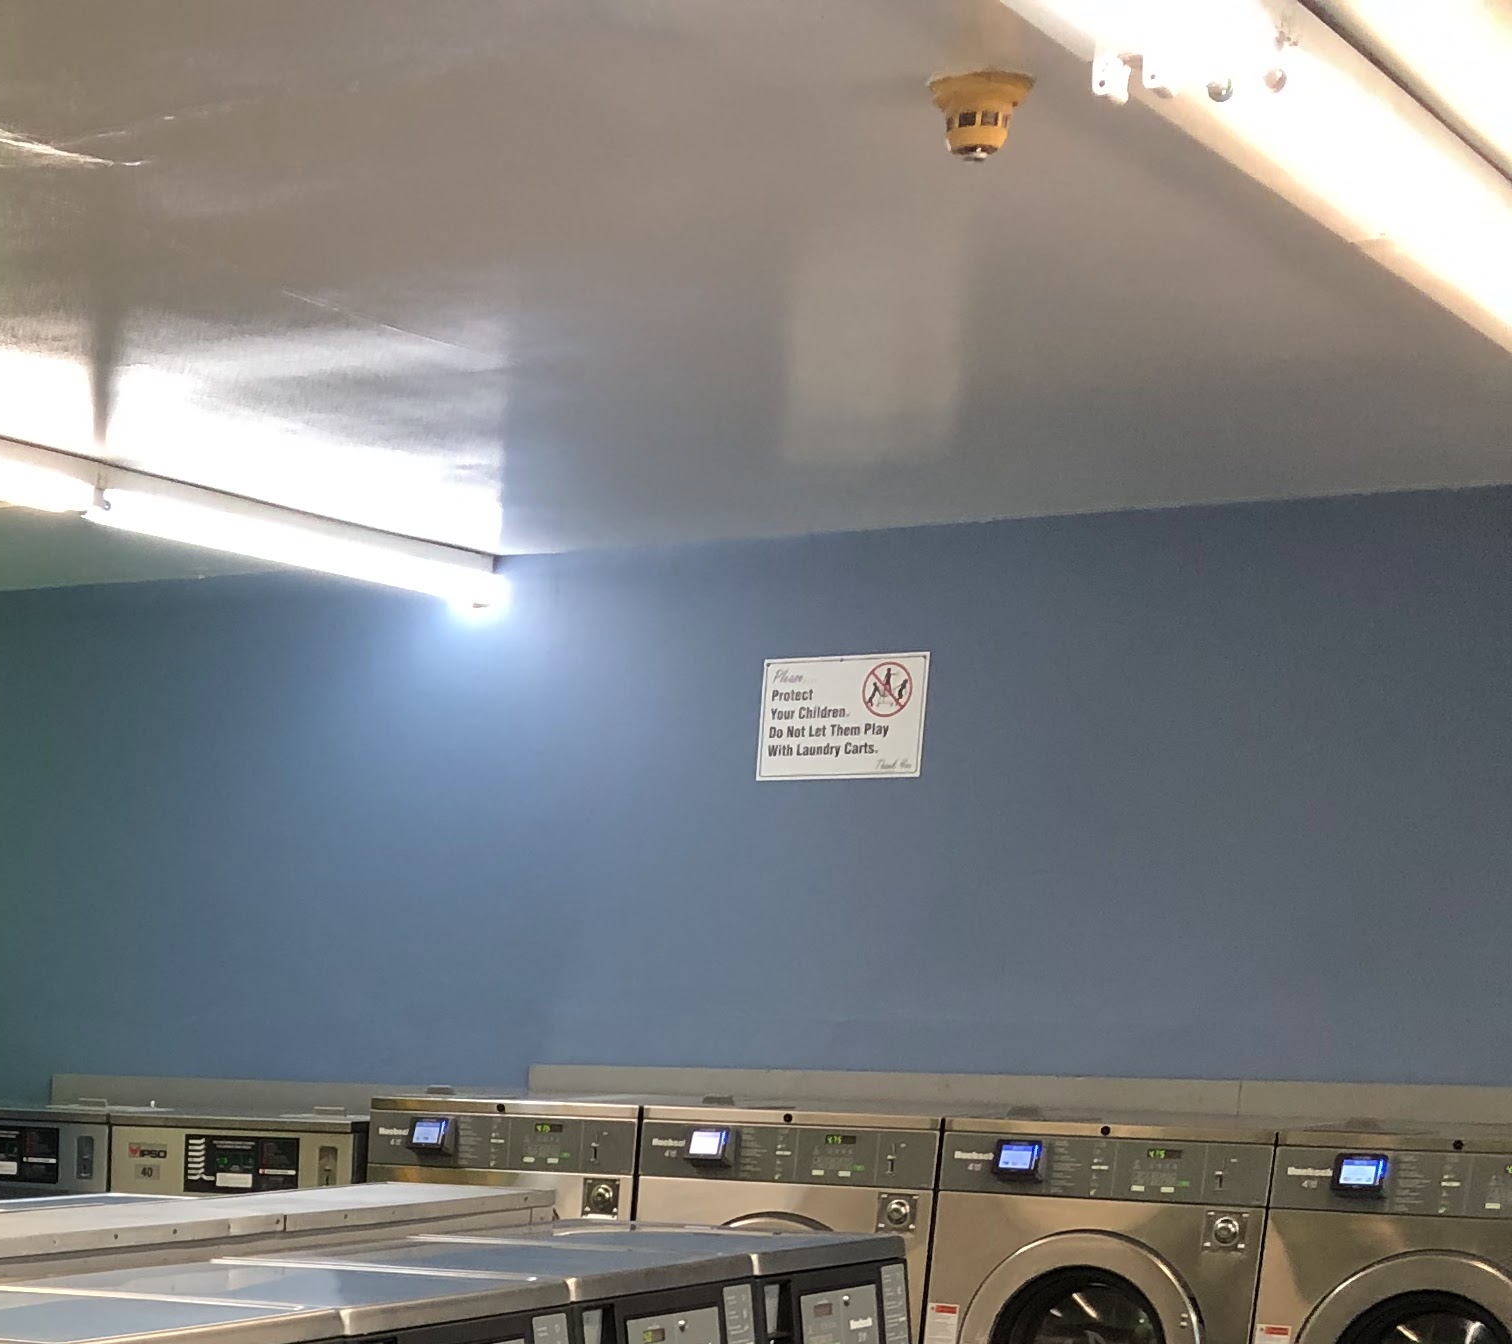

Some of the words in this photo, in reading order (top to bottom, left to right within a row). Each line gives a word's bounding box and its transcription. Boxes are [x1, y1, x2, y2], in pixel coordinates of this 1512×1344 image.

[772, 689, 813, 702] Protect
[771, 707, 795, 721] Your
[799, 706, 850, 720] Children.
[769, 726, 783, 739] Do
[787, 725, 805, 738] Not
[809, 724, 826, 738] Let
[830, 723, 861, 736] Them
[864, 722, 889, 738] Play
[768, 744, 793, 757] With
[796, 743, 841, 758] Laundry
[844, 742, 879, 755] Carts.
[139, 1149, 167, 1159] IPSO
[141, 1167, 153, 1178] 40
